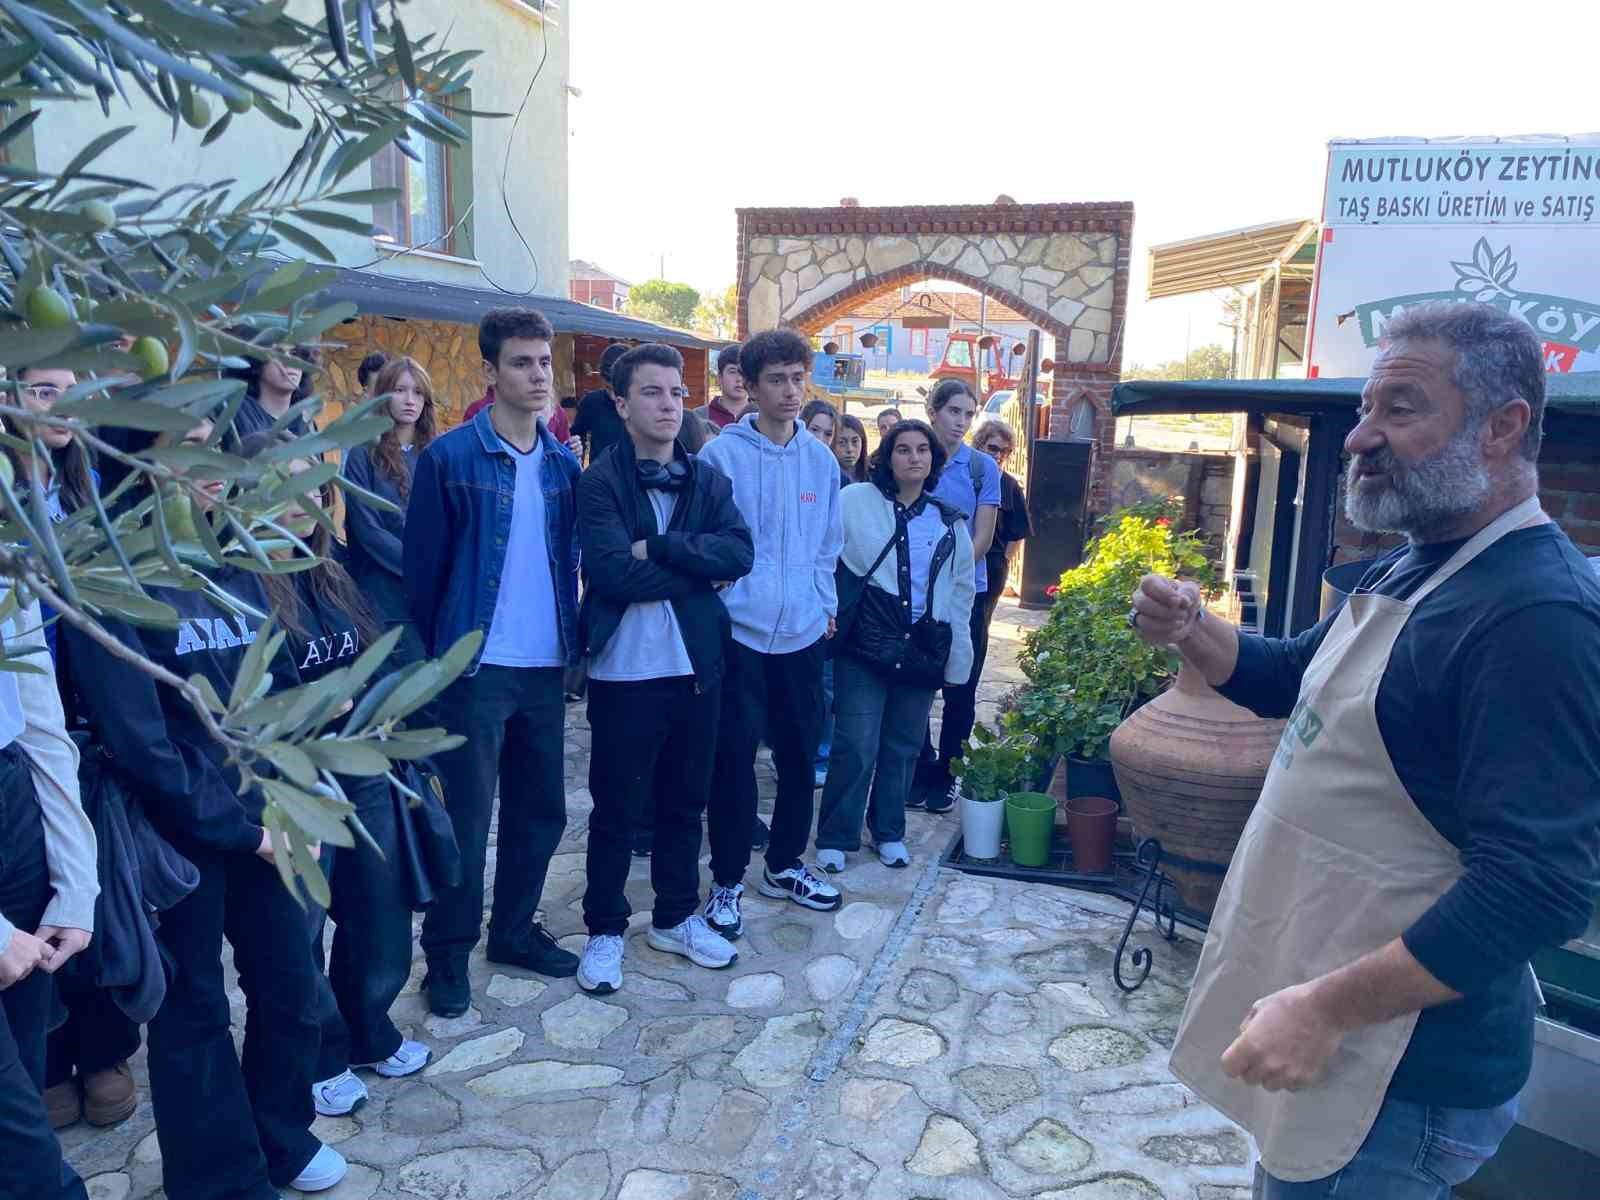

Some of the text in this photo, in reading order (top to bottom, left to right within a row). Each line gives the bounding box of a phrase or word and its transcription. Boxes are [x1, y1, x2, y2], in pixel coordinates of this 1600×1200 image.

[1341, 149, 1491, 182] MUTLUKÖY
[1338, 190, 1595, 221] TAŞ BASKI ÜRETİM ve SATIŞ
